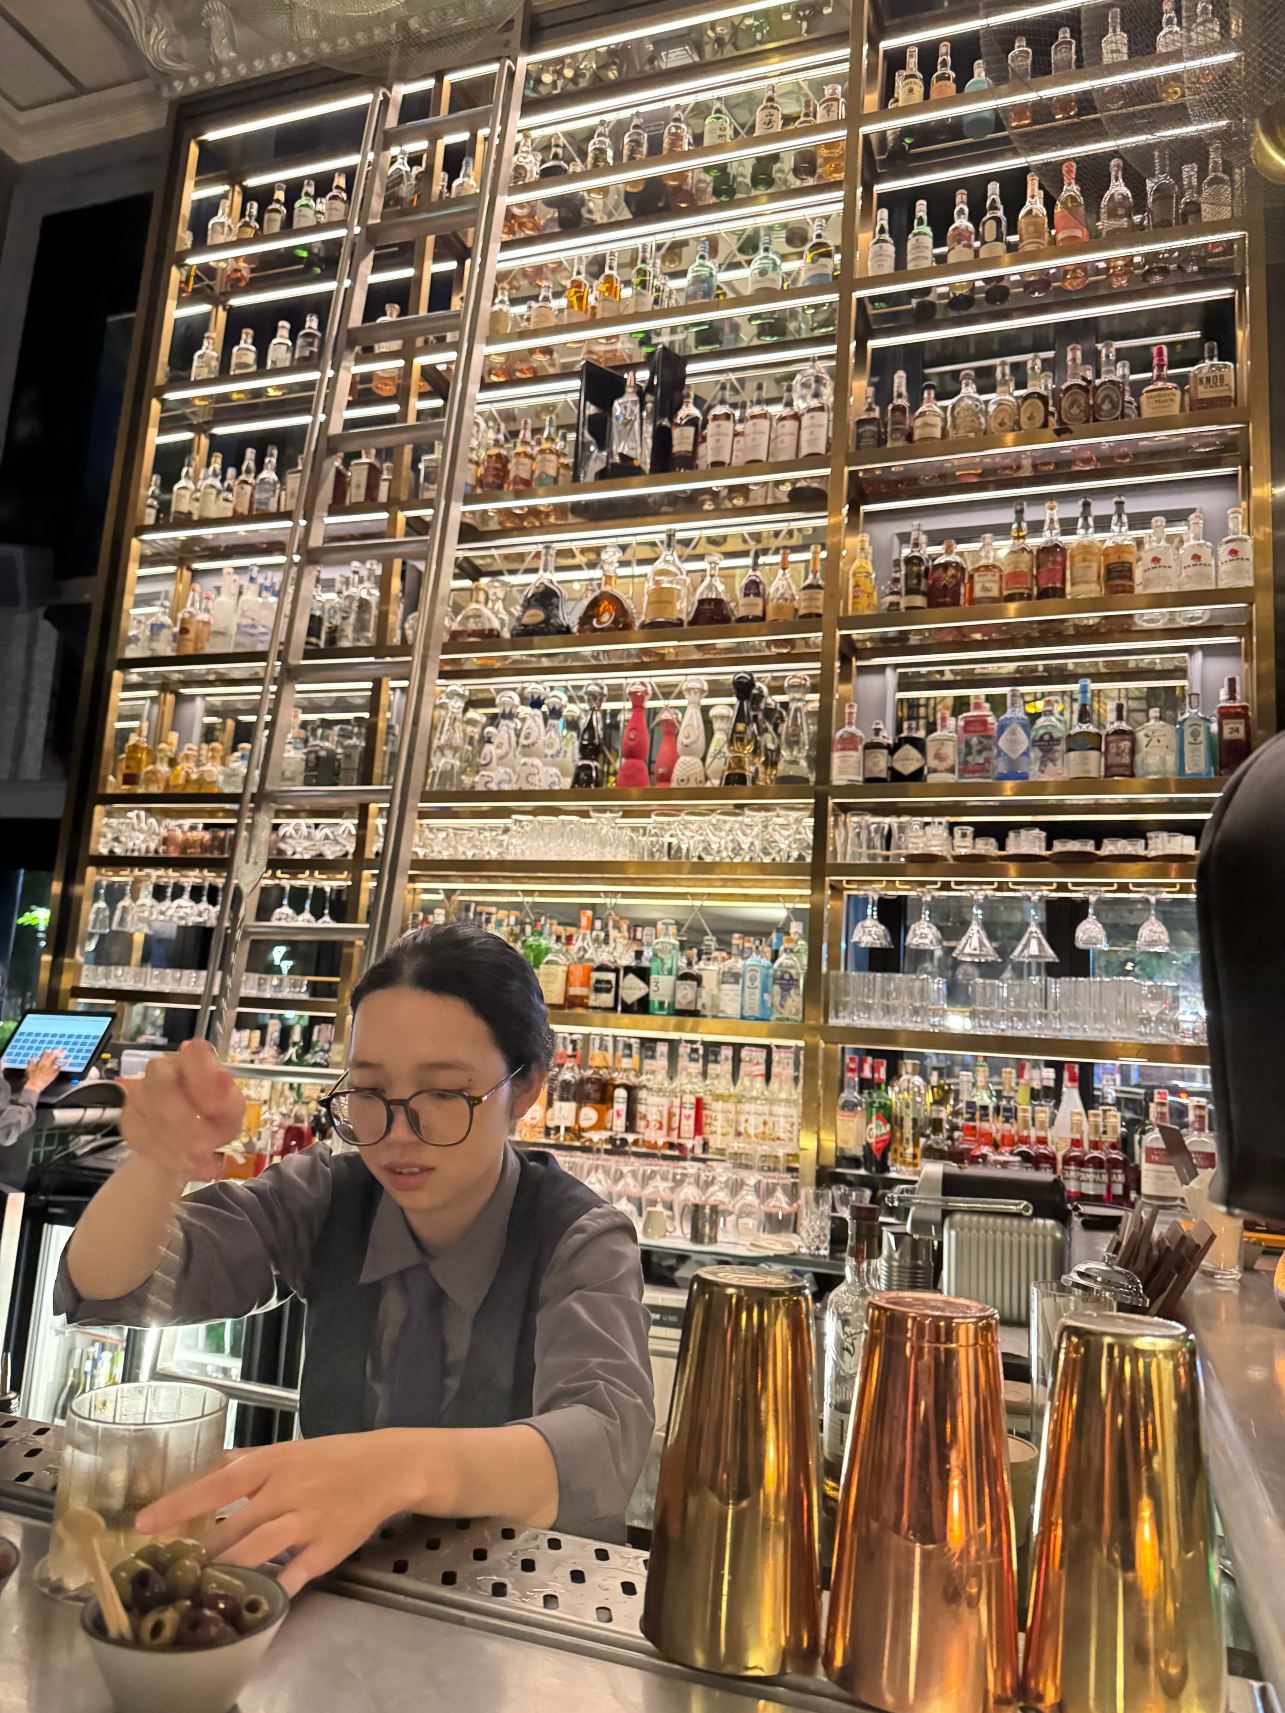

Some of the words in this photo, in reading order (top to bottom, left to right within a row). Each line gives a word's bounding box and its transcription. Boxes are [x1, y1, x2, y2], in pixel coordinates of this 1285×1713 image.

[1198, 374, 1225, 387] KNOB
[1228, 726, 1240, 735] 24
[652, 981, 660, 993] 3
